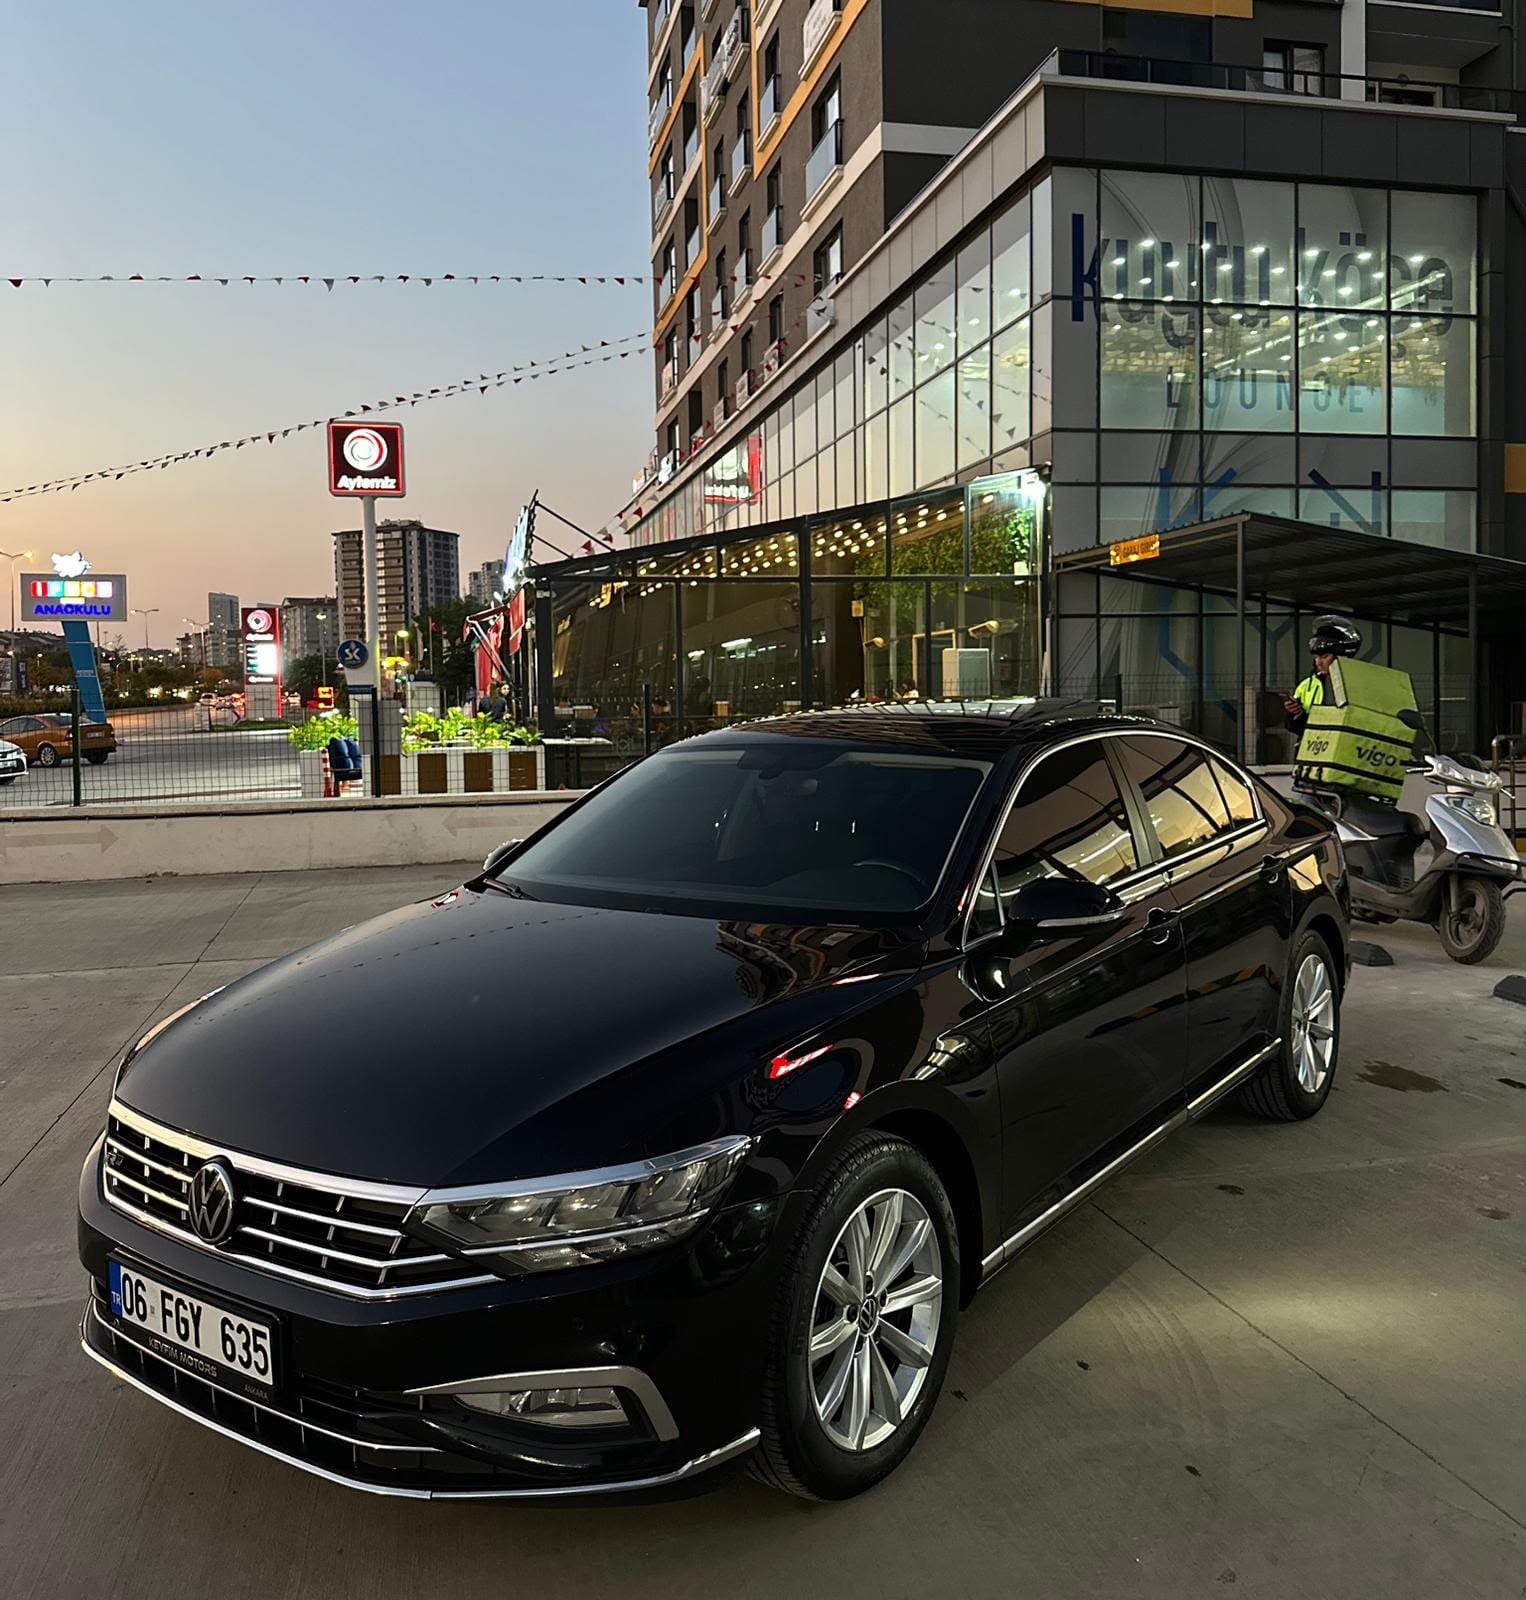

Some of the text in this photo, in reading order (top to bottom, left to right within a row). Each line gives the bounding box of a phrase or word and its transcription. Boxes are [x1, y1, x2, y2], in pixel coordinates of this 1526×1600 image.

[1071, 213, 1271, 350] kuytu
[34, 603, 112, 616] ANAOKULU
[1306, 736, 1329, 756] vigo
[1356, 745, 1398, 767] vigo
[111, 1272, 269, 1377] TR 06 FGY 635
[179, 1351, 218, 1378] MOTORS
